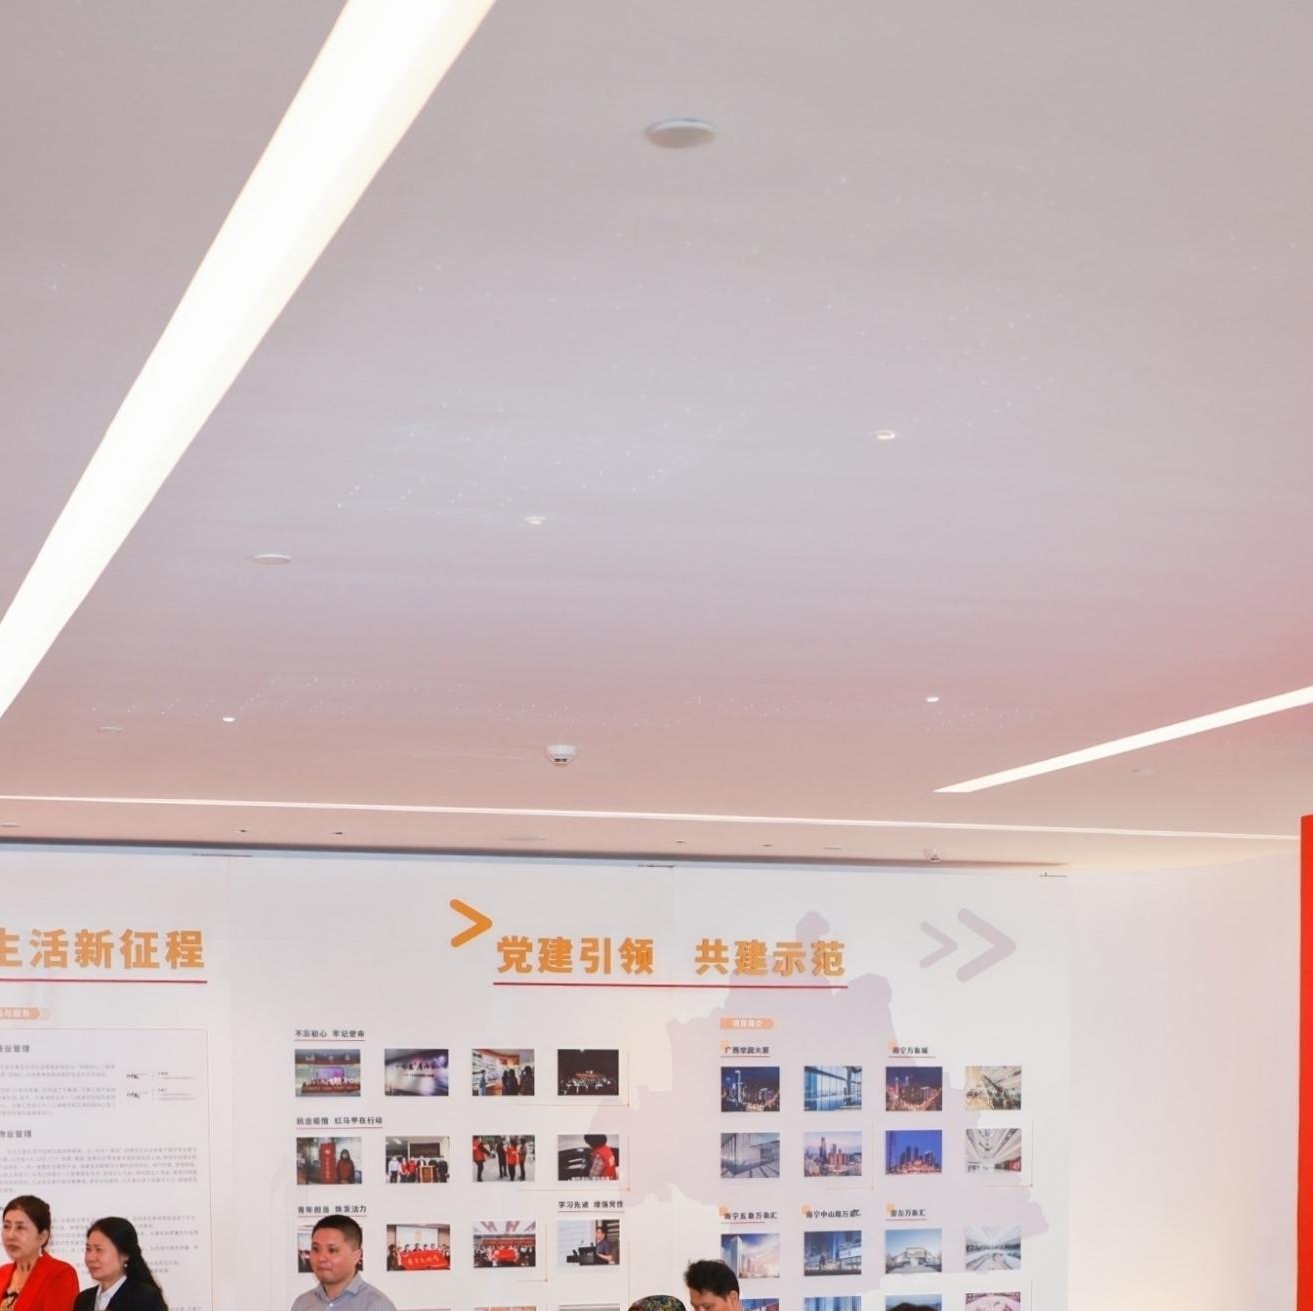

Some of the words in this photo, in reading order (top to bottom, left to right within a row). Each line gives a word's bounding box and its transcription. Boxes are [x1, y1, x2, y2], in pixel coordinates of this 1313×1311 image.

[496, 936, 655, 975] 党建引领
[694, 938, 846, 977] 共建示范
